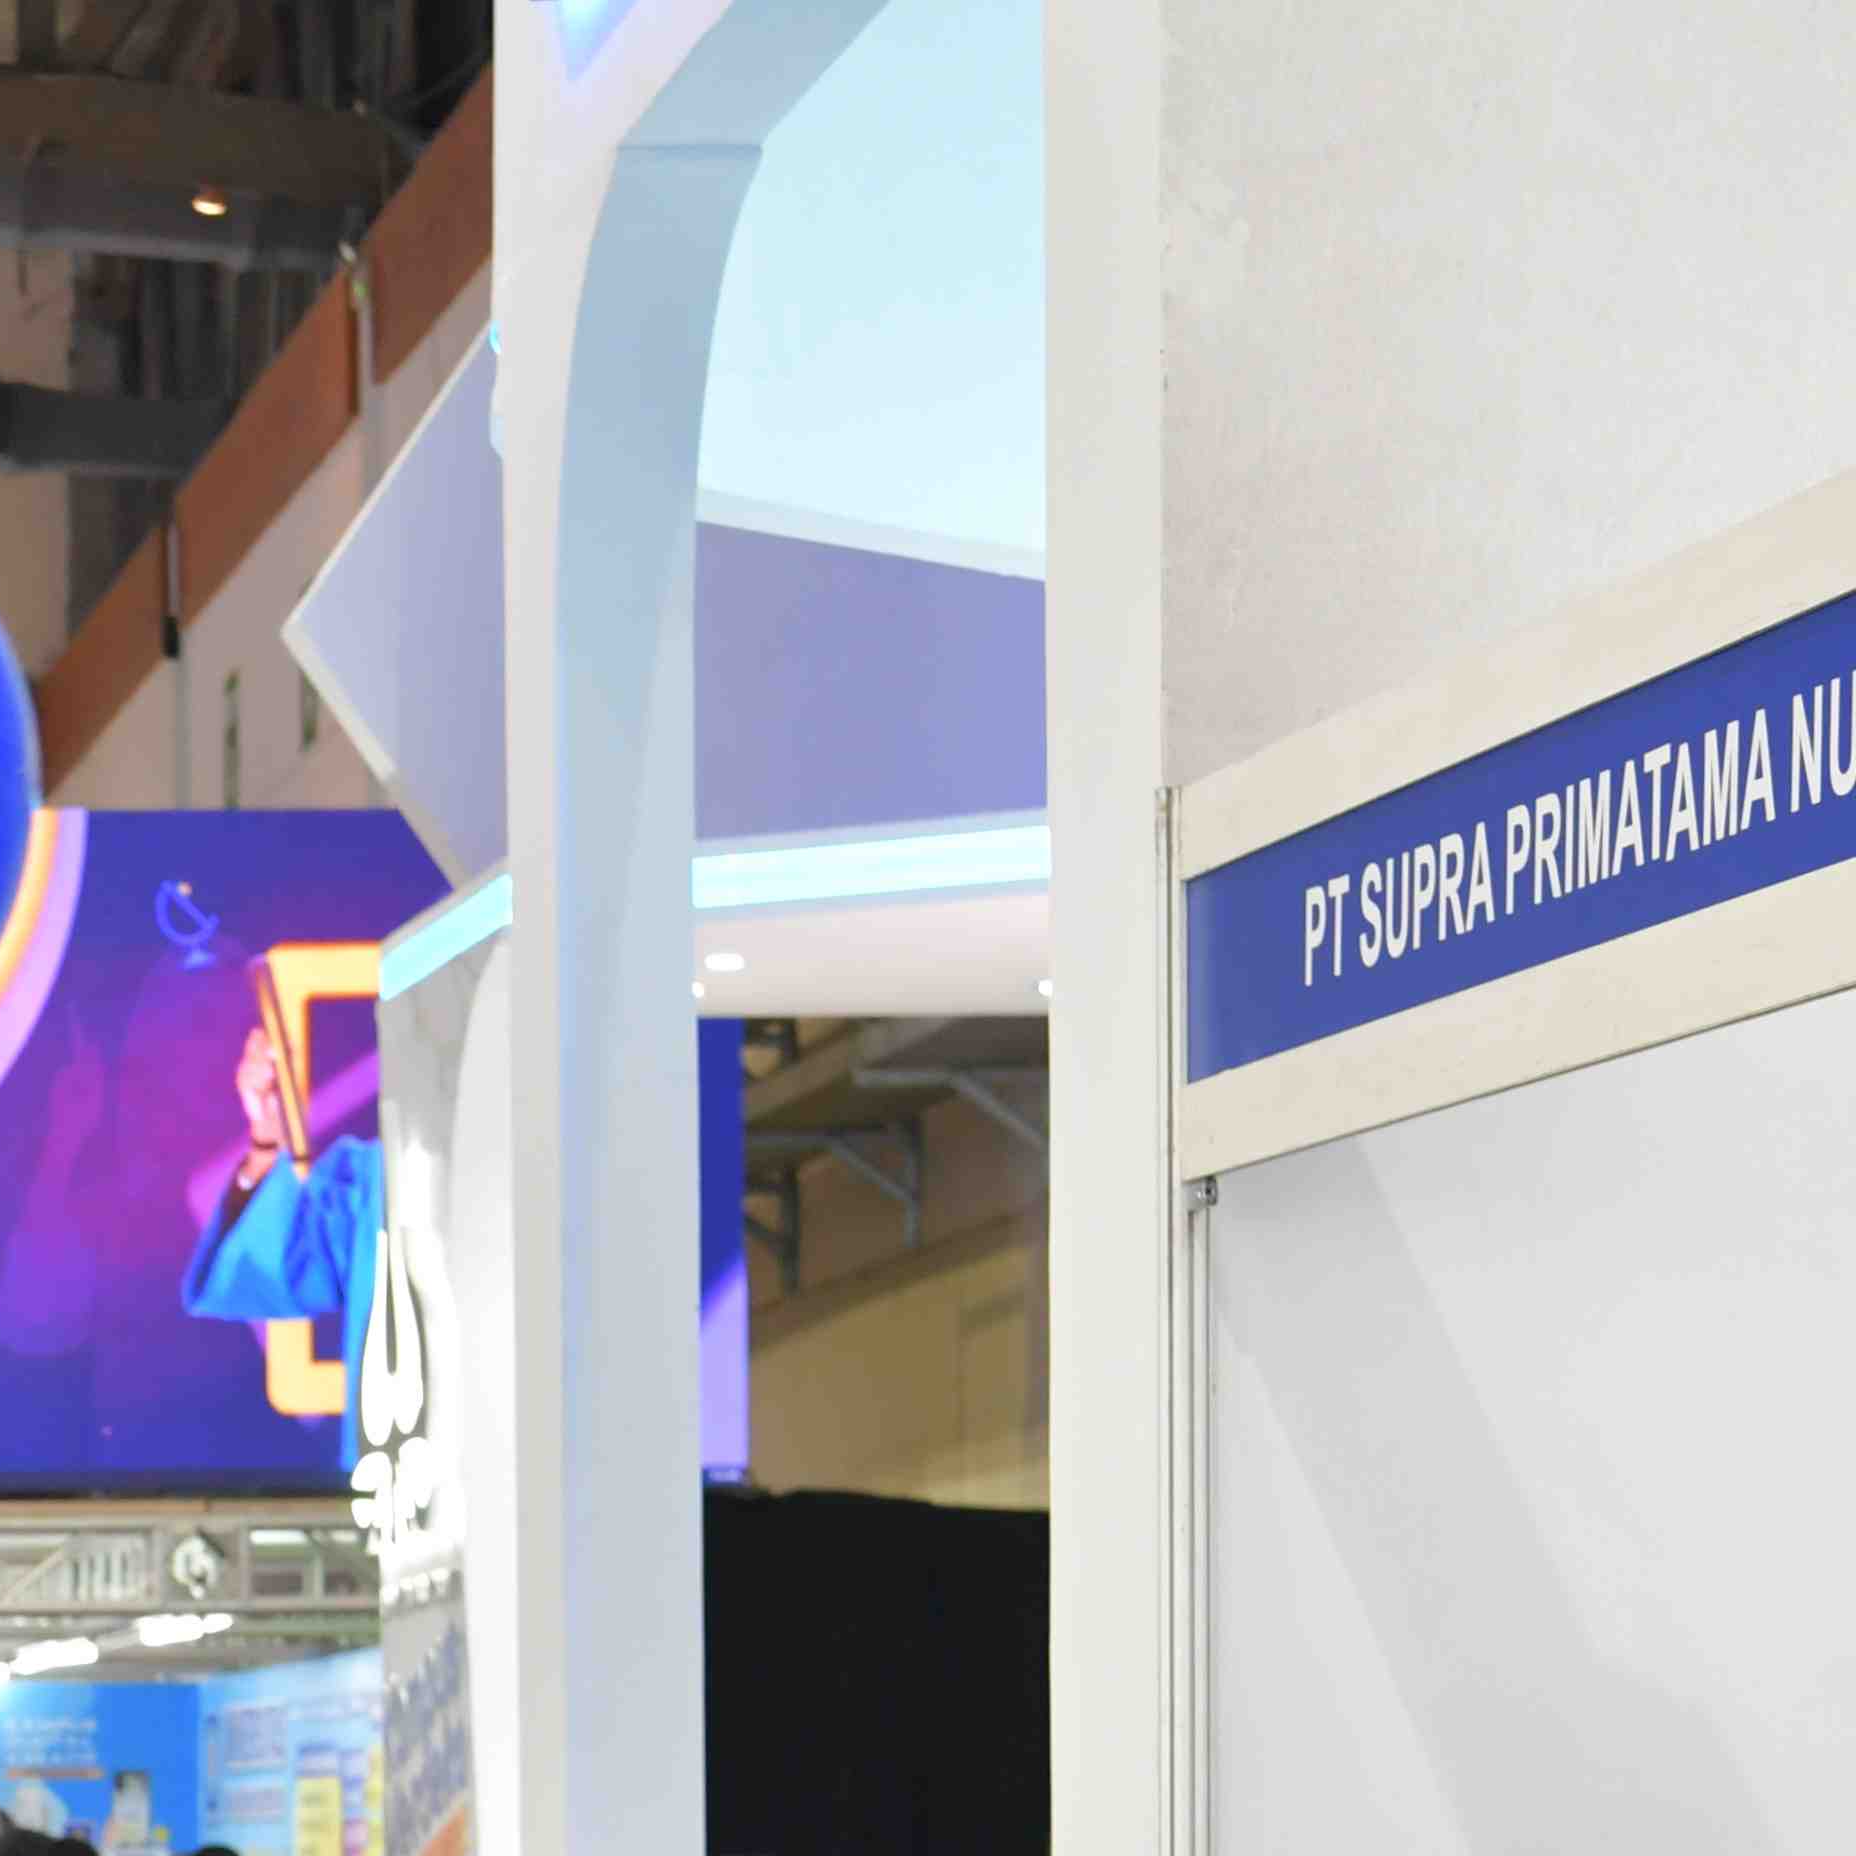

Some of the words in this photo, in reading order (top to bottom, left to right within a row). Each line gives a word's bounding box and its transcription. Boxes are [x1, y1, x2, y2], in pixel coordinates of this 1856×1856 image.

[1304, 873, 1350, 988] PT
[1359, 821, 1495, 970] SUPRA
[1505, 707, 1776, 915] PRIMATAMA
